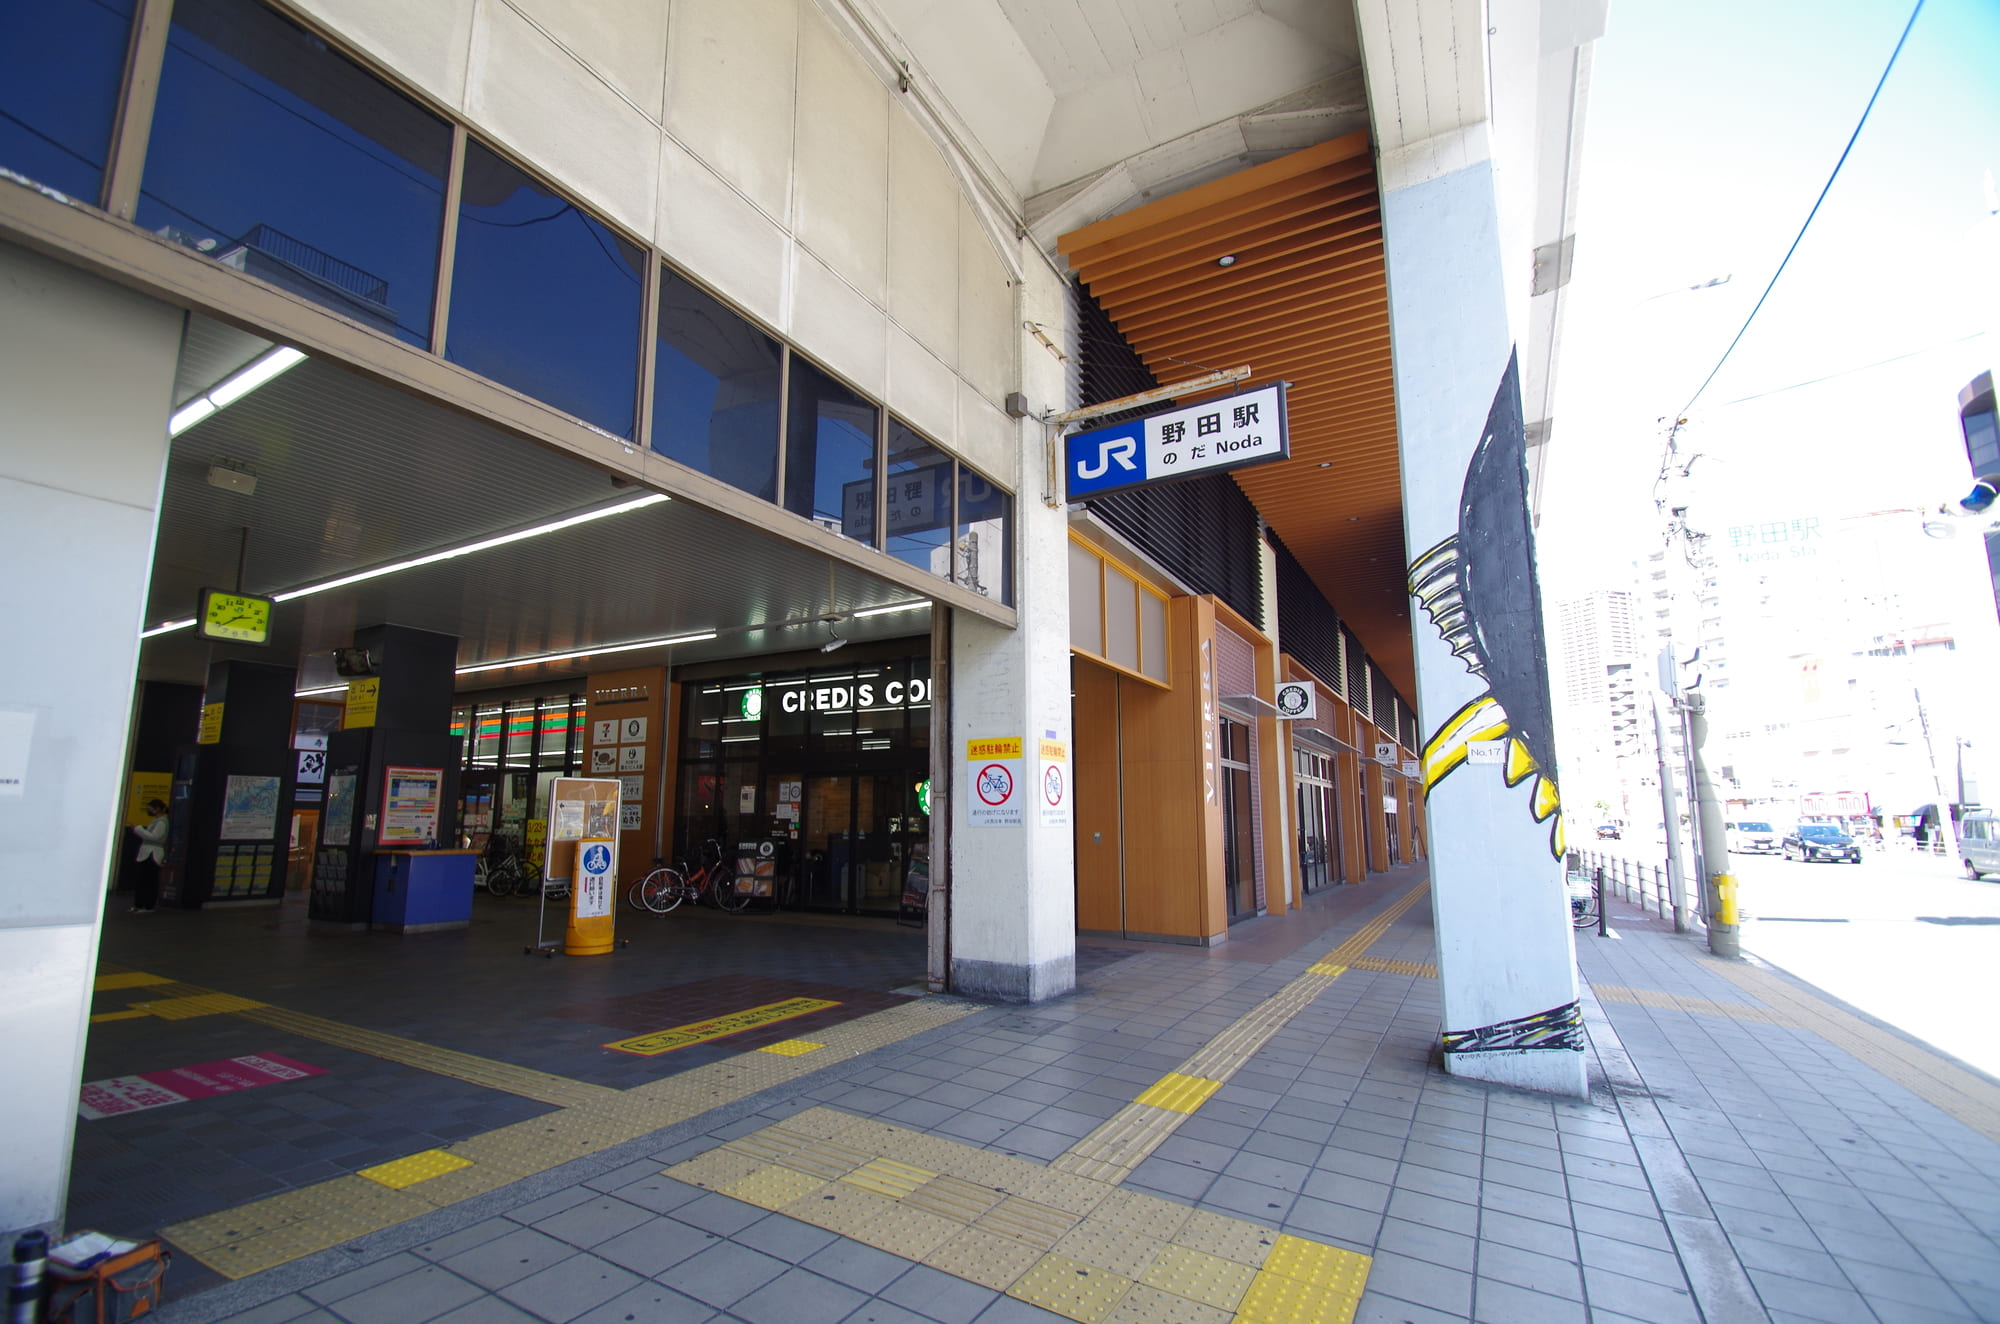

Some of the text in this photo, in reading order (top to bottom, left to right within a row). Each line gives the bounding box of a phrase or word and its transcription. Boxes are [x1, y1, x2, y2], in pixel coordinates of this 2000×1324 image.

[1161, 403, 1260, 445] 野田駅
[1216, 434, 1263, 455] Noda
[1077, 436, 1138, 480] JR
[1728, 516, 1822, 547] 野田駅
[782, 683, 874, 713] CREDIS
[1282, 706, 1304, 714] COFFEE
[971, 742, 1020, 756] 迷惑駐輪禁止
[1471, 747, 1501, 757] No.17
